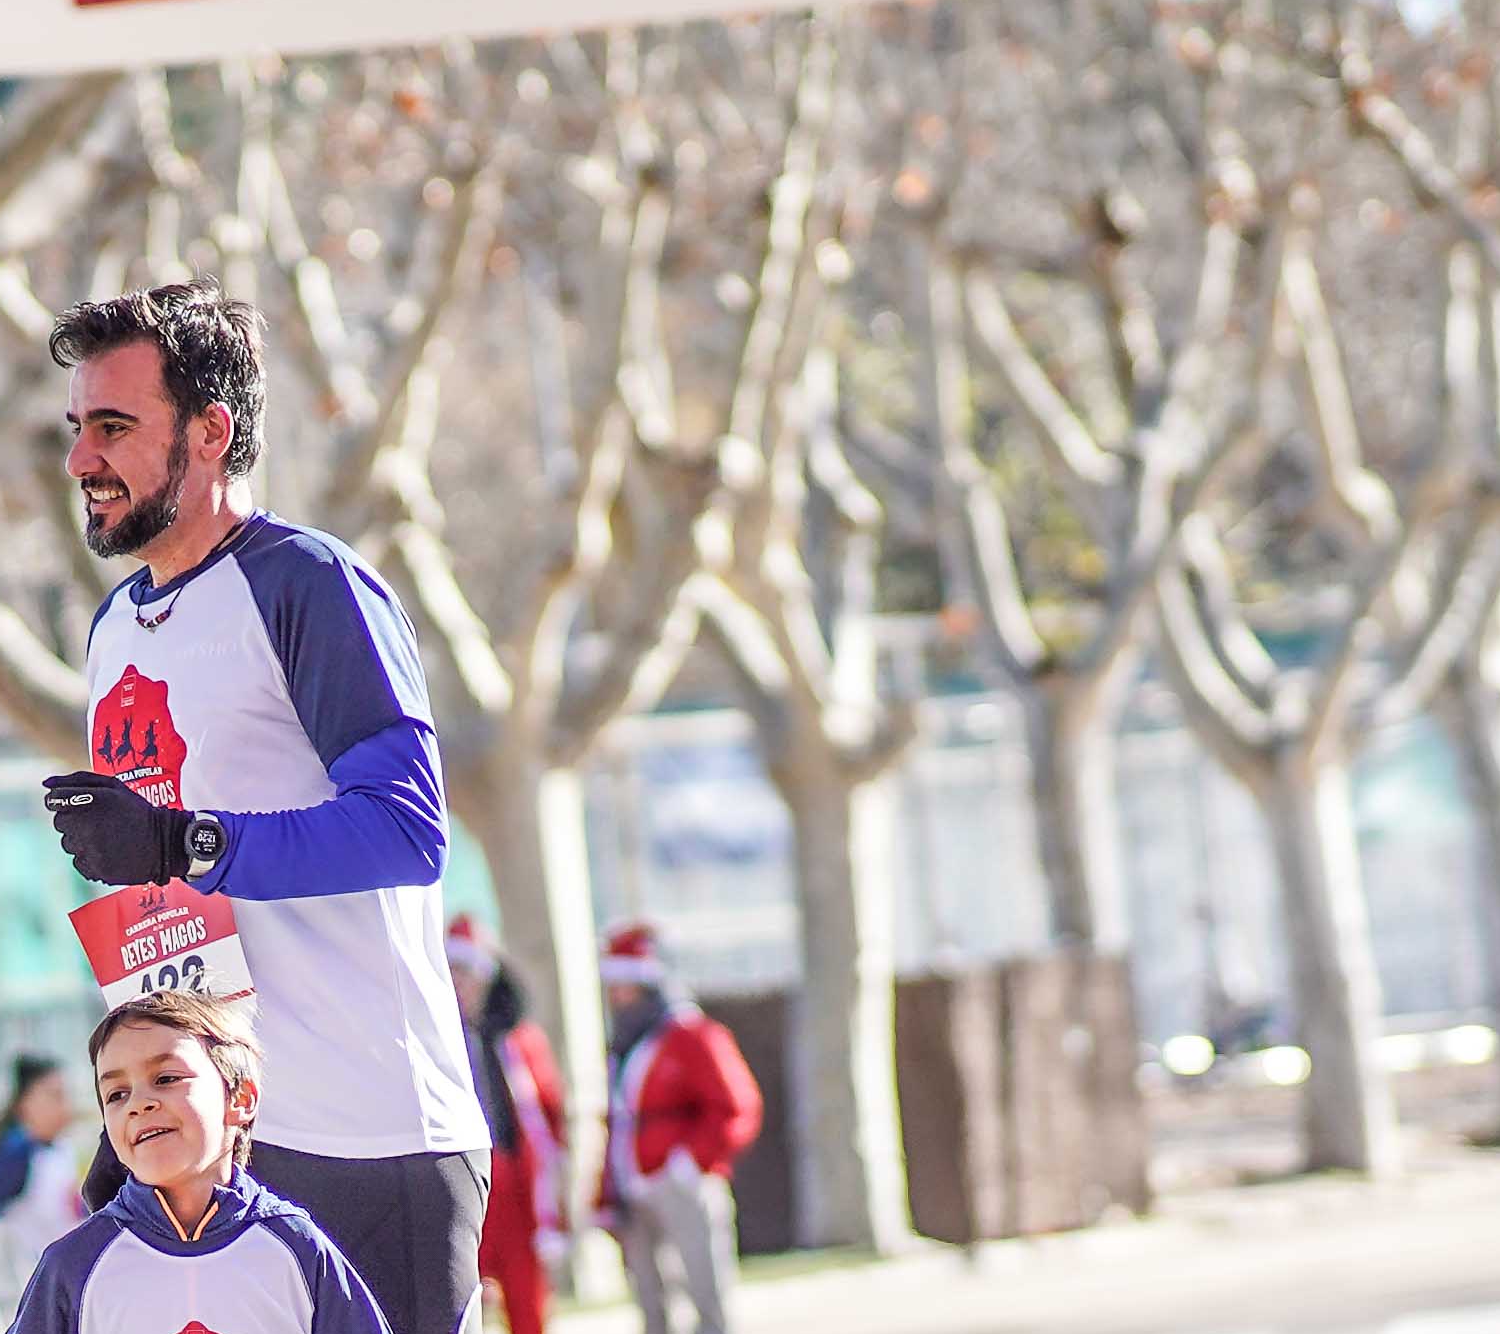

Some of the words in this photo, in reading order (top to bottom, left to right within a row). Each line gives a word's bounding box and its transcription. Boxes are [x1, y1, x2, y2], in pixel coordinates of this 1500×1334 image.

[126, 917, 157, 936] CARRERA
[158, 907, 189, 922] POPULAR
[120, 935, 157, 971] REYES
[160, 916, 207, 955] MAGOS
